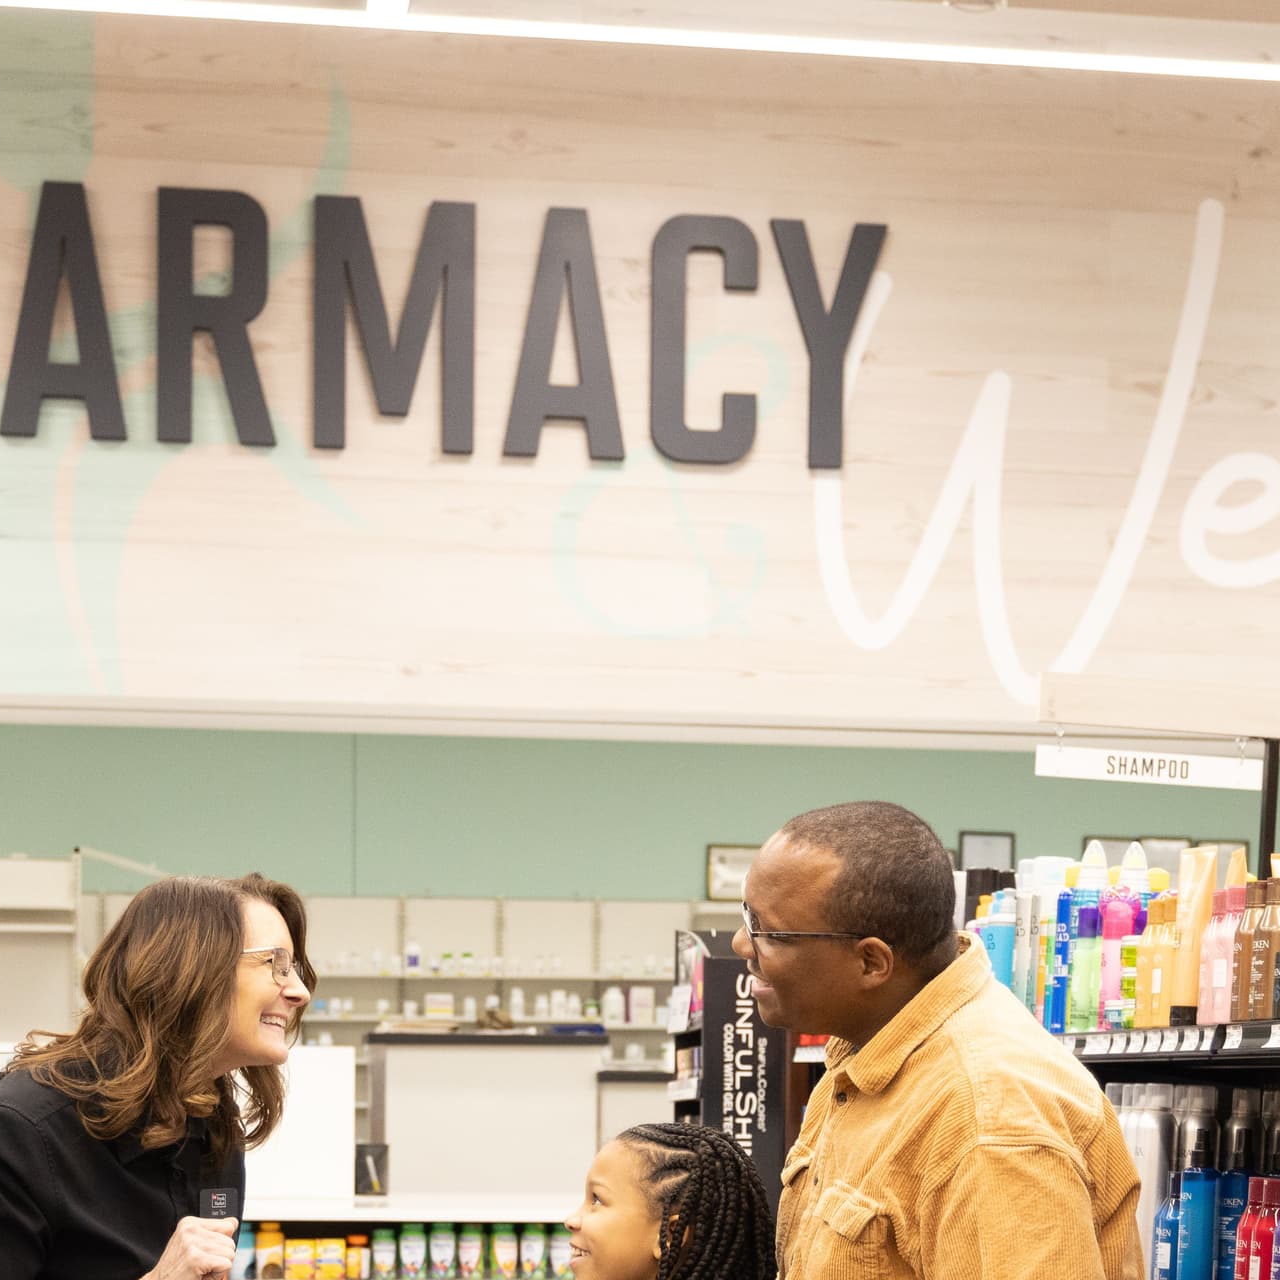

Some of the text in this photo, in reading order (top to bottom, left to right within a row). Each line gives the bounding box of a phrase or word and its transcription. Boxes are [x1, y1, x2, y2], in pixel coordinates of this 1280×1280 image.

[1106, 754, 1190, 780] SHAMPOO
[723, 1023, 734, 1062] COLOR
[735, 972, 758, 1157] SINFULSHI
